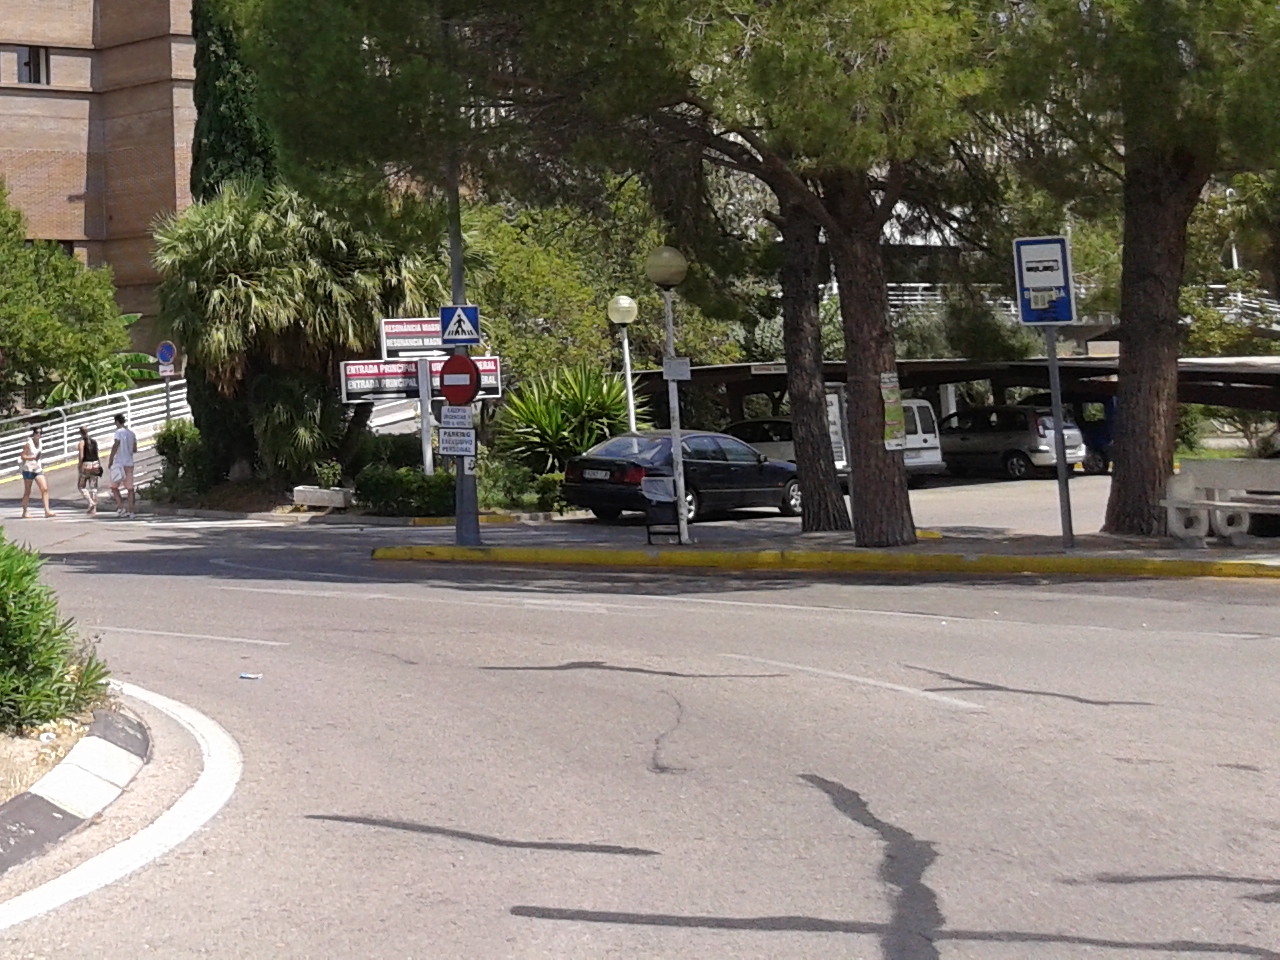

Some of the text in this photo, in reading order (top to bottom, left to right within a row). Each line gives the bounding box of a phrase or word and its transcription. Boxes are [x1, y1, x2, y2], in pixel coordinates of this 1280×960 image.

[346, 363, 417, 375] ENTRADA PRINCIPAL
[347, 378, 418, 389] ENTRADA PRINCIPAL
